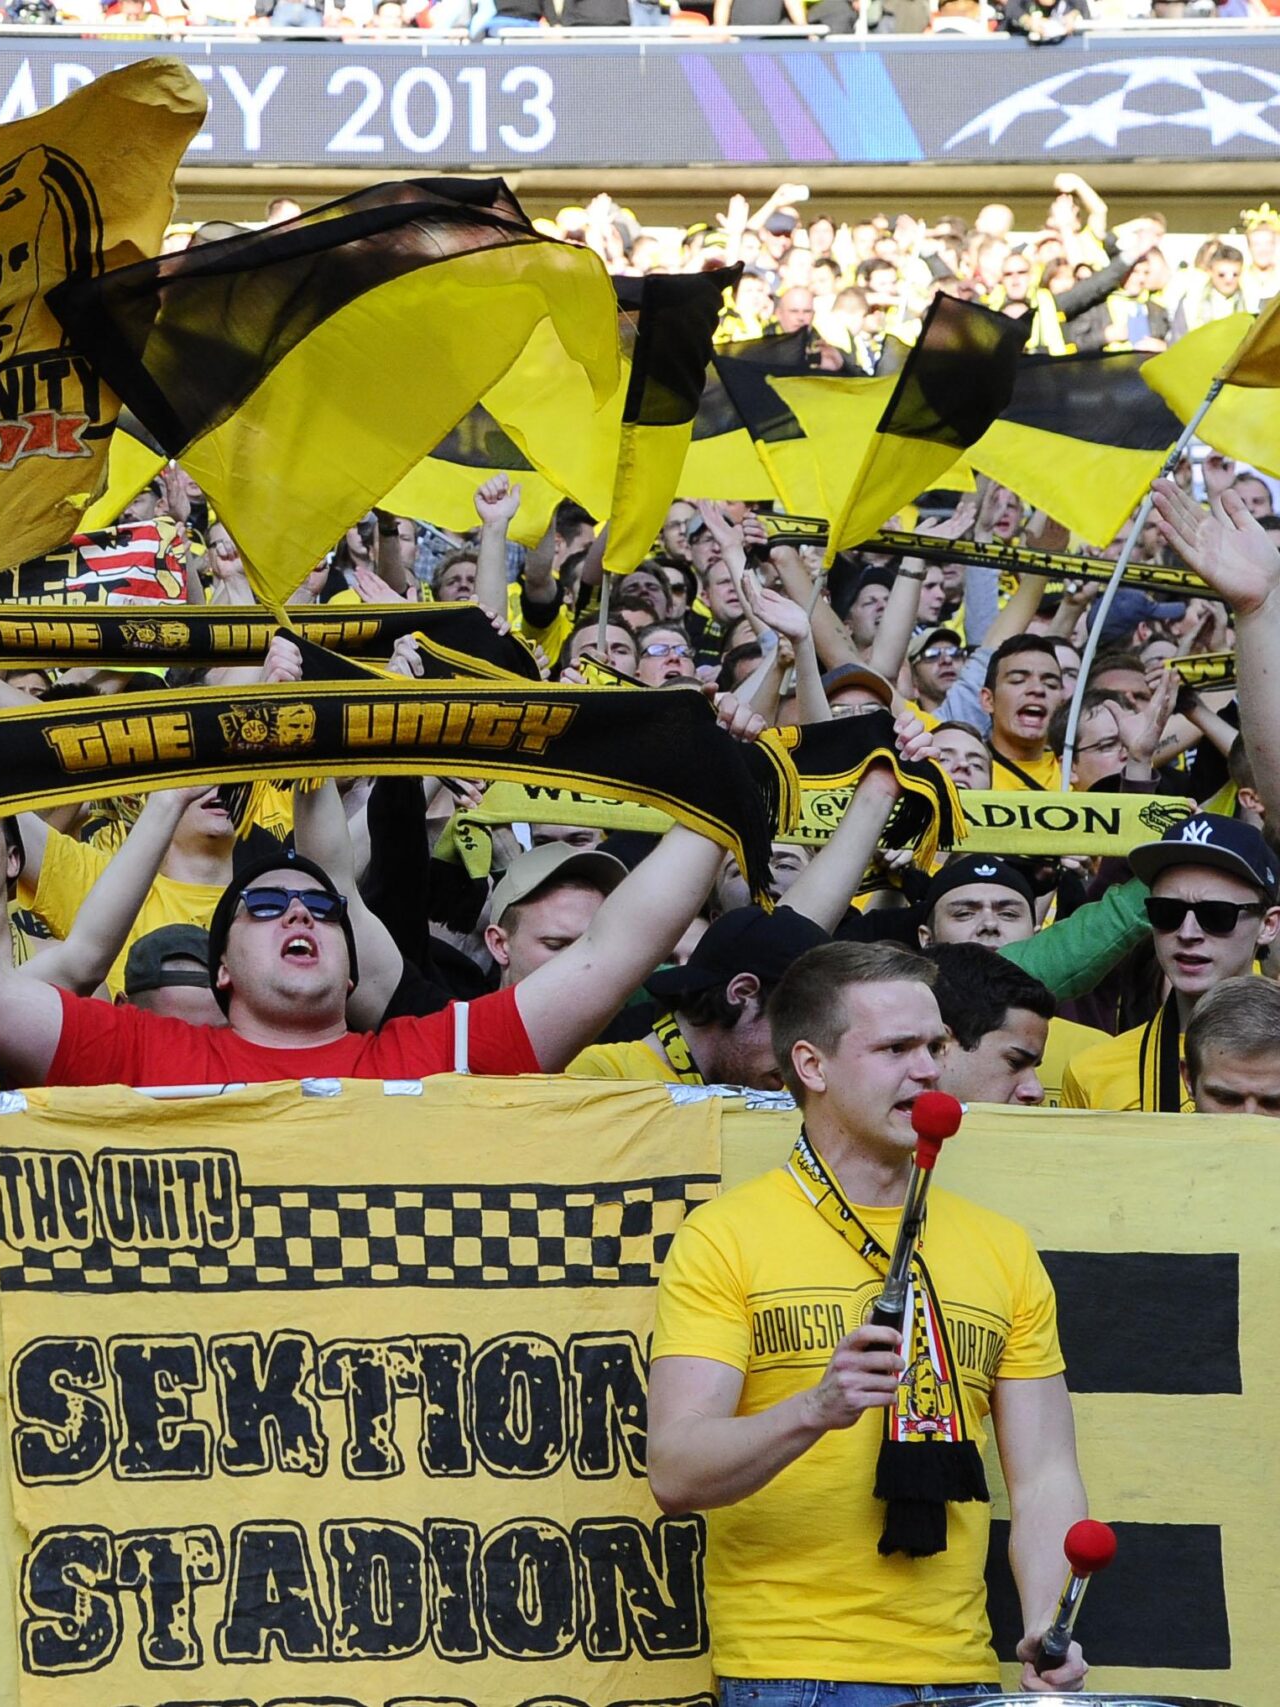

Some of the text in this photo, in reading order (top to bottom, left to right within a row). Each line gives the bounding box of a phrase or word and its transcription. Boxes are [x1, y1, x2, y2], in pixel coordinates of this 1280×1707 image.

[325, 65, 556, 153] 2013
[43, 700, 580, 775] THE UNITY
[751, 1302, 846, 1357] BORUSSIA
[10, 1331, 650, 1486] SEKTION
[22, 1518, 710, 1676] STADION
